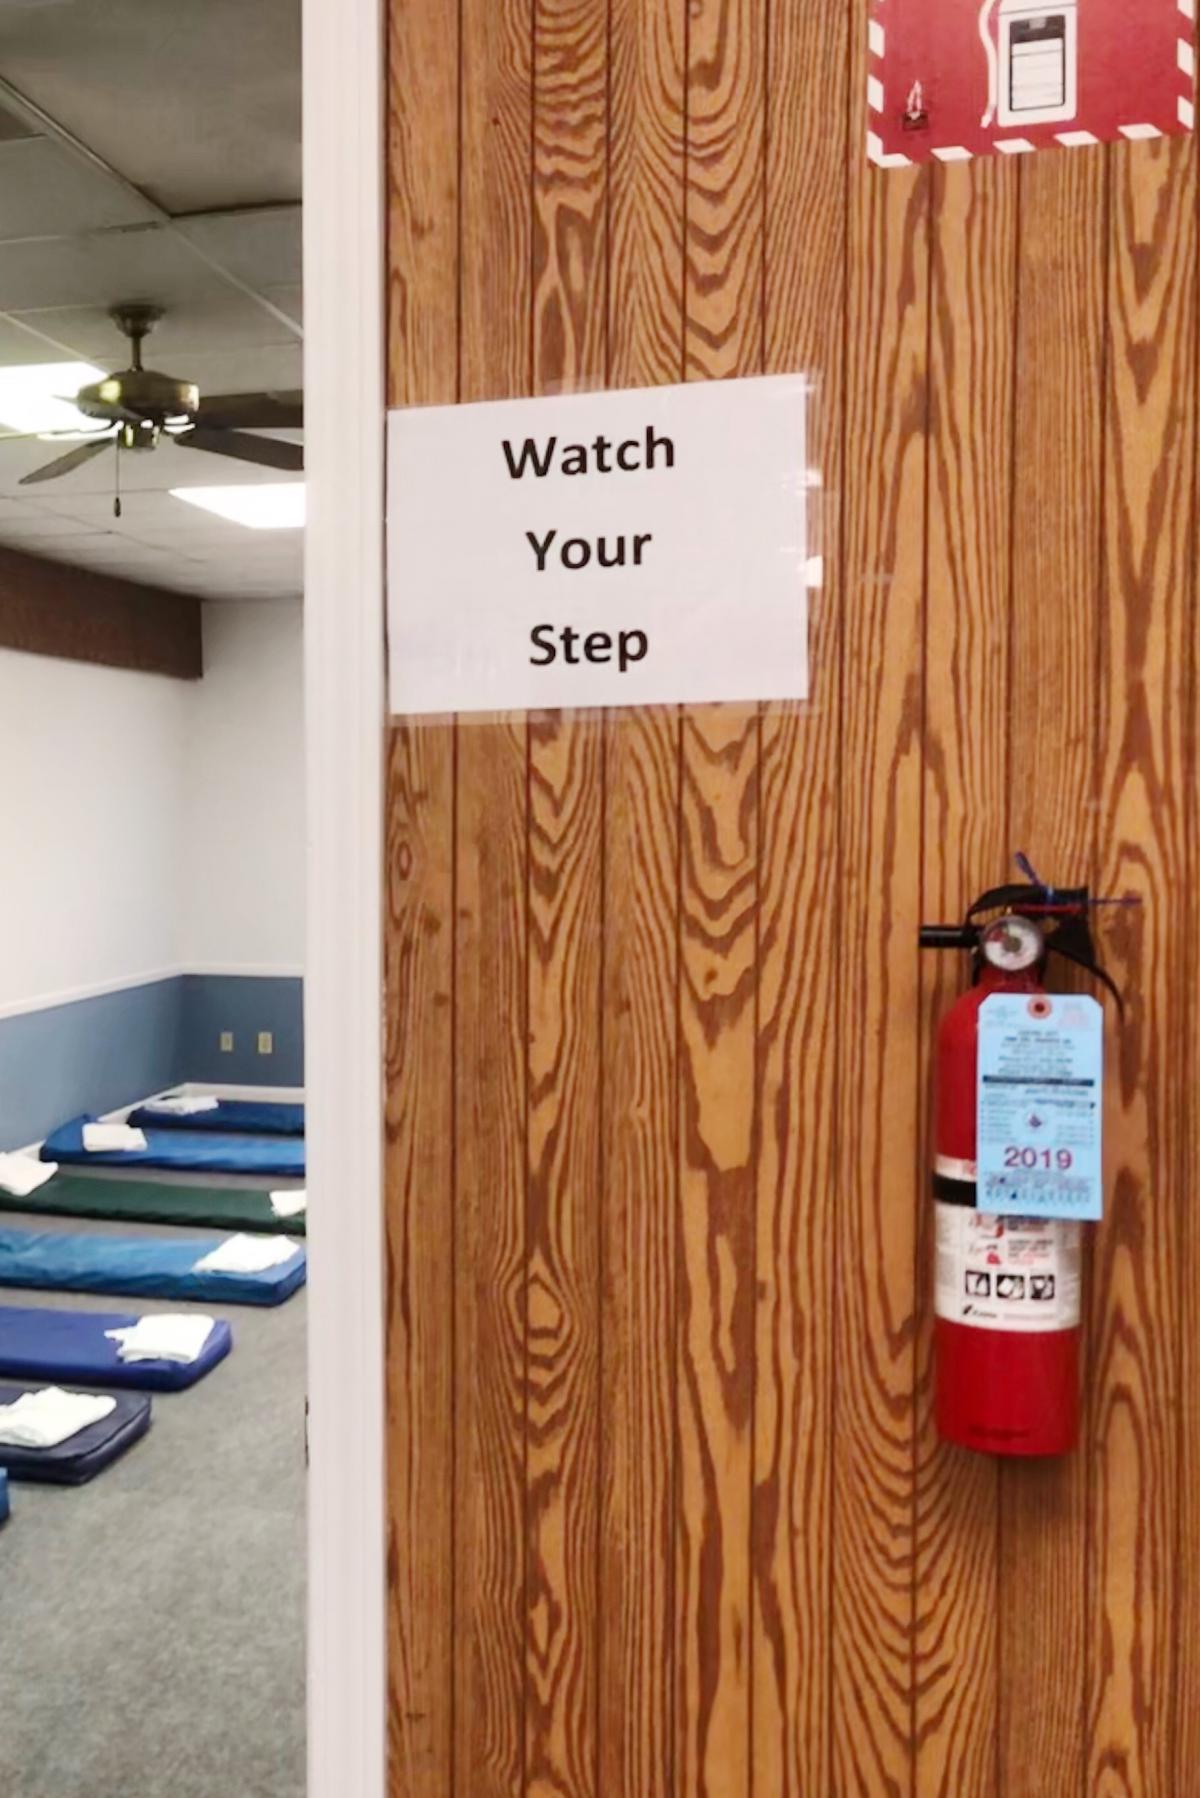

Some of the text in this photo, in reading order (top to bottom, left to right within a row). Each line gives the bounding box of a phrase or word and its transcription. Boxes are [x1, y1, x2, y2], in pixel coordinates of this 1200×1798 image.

[502, 426, 674, 480] Watch
[526, 530, 652, 571] Your
[530, 625, 648, 673] Step
[1004, 1146, 1072, 1170] 2019
